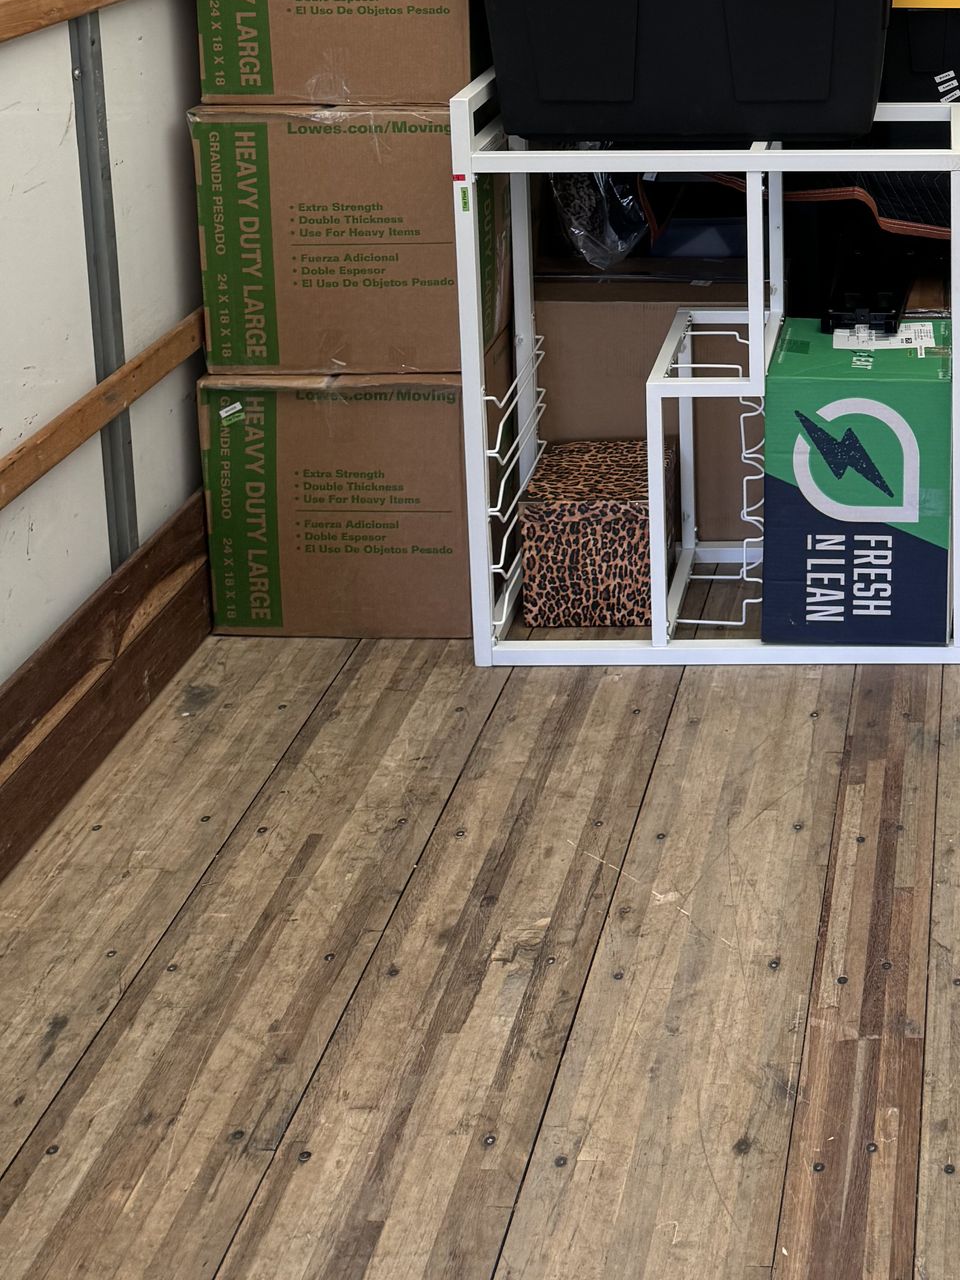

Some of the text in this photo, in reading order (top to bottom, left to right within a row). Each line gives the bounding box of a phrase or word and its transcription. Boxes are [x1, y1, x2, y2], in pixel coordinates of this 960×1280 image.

[296, 6, 450, 17] El Uso De Objetos Pesado
[210, 0, 226, 87] 24 X 18 X 18
[236, 12, 262, 87] LARGE
[287, 121, 451, 136] Lowes.com/Moving
[209, 131, 226, 256] GRANDE PESADO
[298, 202, 383, 214] Extra Strength
[299, 215, 403, 225] Double Thickness
[234, 131, 267, 359] HEAVY DUTY LARGE
[299, 227, 421, 239] Use For Heavy Items
[301, 253, 399, 263] Fuerza Adicional
[301, 267, 386, 278] Doble Espesor
[302, 278, 455, 289] El Uso De Objetos Pesado
[217, 273, 232, 358] 24 X 18 X 18
[220, 460, 232, 520] PESADO
[245, 396, 271, 620] HEAVY DUTY LARGE
[806, 558, 846, 622] LEAN
[852, 535, 893, 616] FRESH
